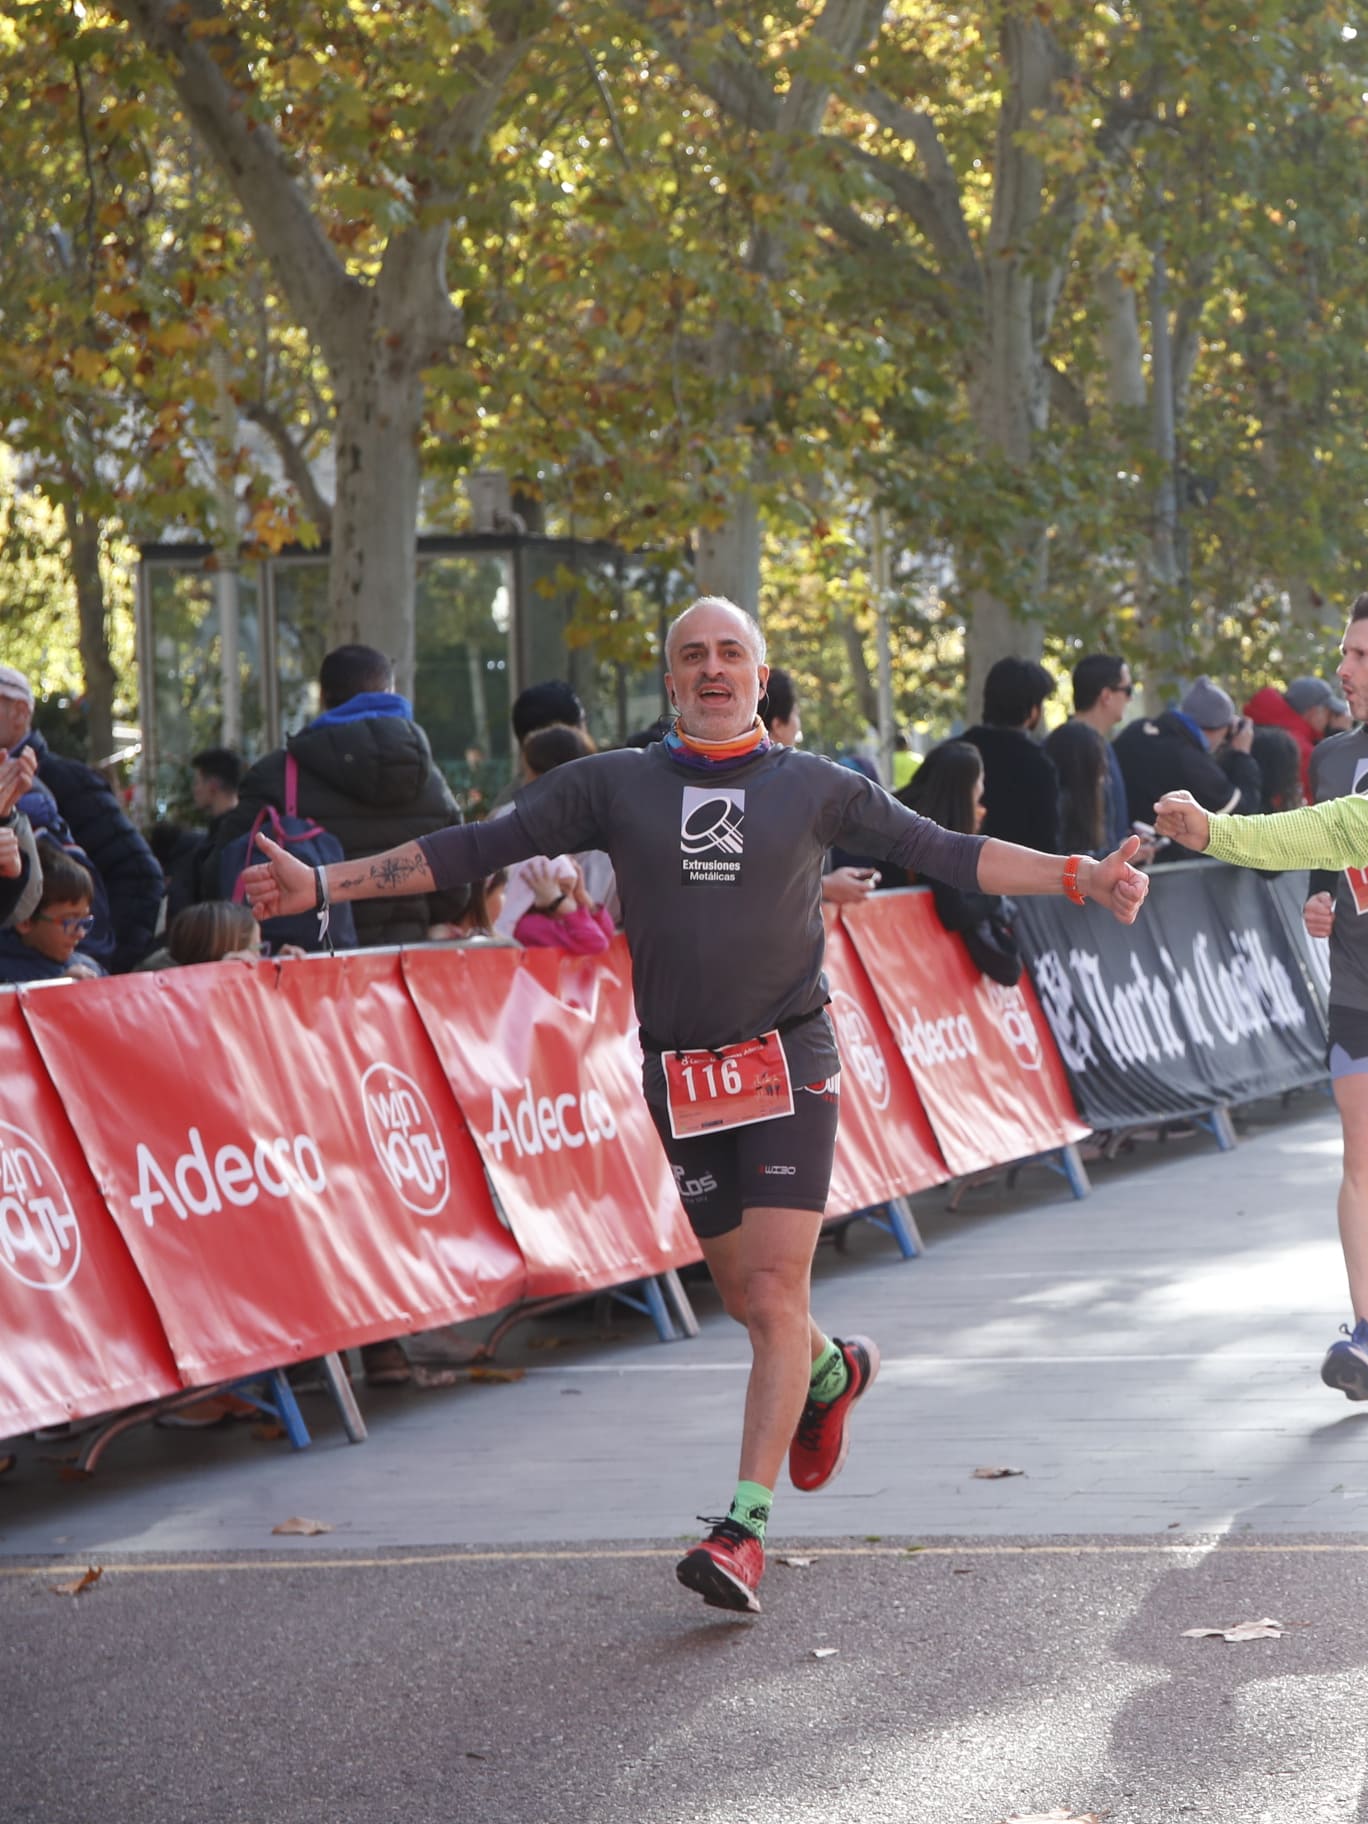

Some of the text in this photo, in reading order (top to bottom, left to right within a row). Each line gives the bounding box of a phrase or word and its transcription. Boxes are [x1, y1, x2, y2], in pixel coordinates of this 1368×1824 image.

[682, 859, 741, 871] Extrusiones
[896, 1006, 980, 1068] Adecco
[681, 1059, 743, 1102] 116
[486, 1076, 618, 1160] Adecco
[130, 1127, 327, 1228] Adecco
